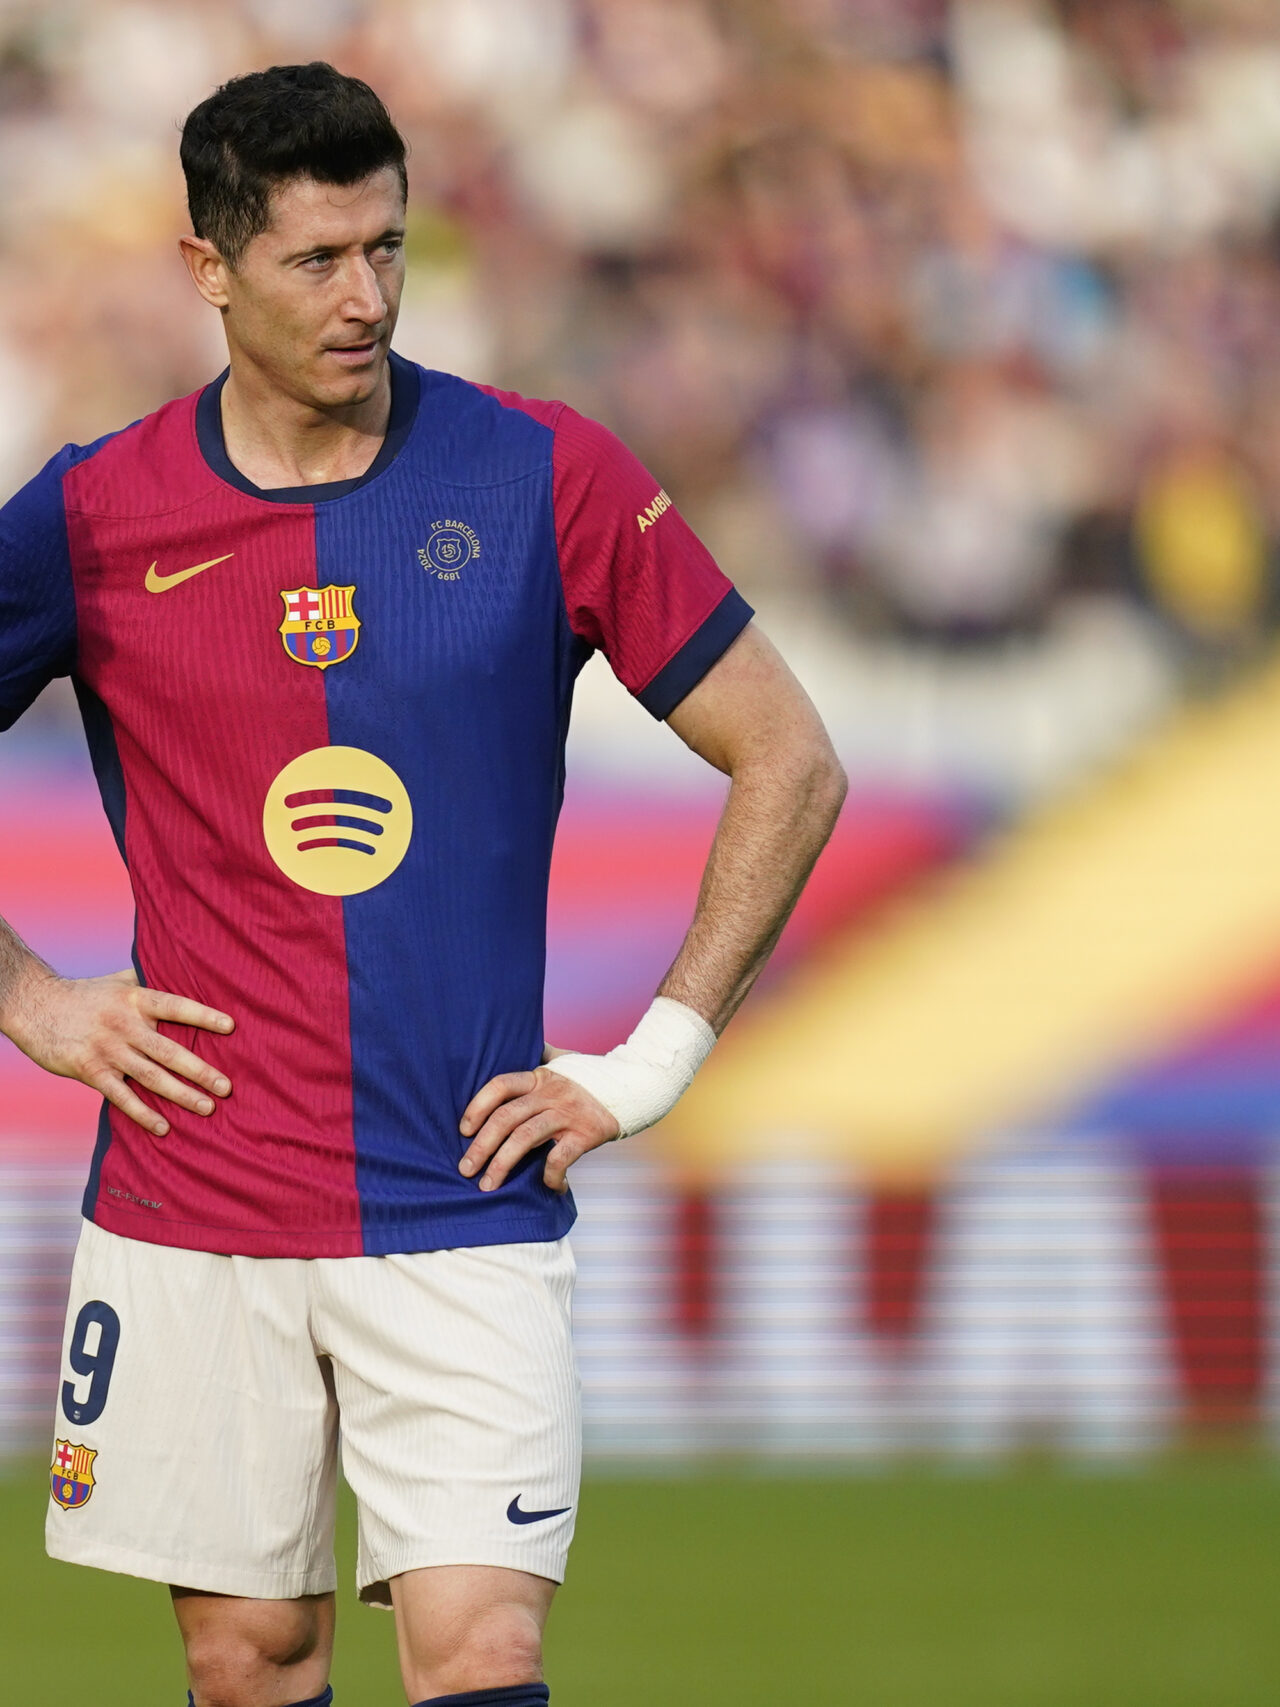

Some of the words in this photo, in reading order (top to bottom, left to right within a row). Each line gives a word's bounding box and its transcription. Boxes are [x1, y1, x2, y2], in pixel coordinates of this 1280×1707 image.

[430, 520, 443, 531] FC
[445, 519, 481, 559] BARCELONA
[417, 548, 432, 571] 2024
[437, 571, 461, 581] 1899
[304, 619, 336, 631] FCB
[61, 1299, 121, 1426] 9
[61, 1468, 79, 1481] FCB
